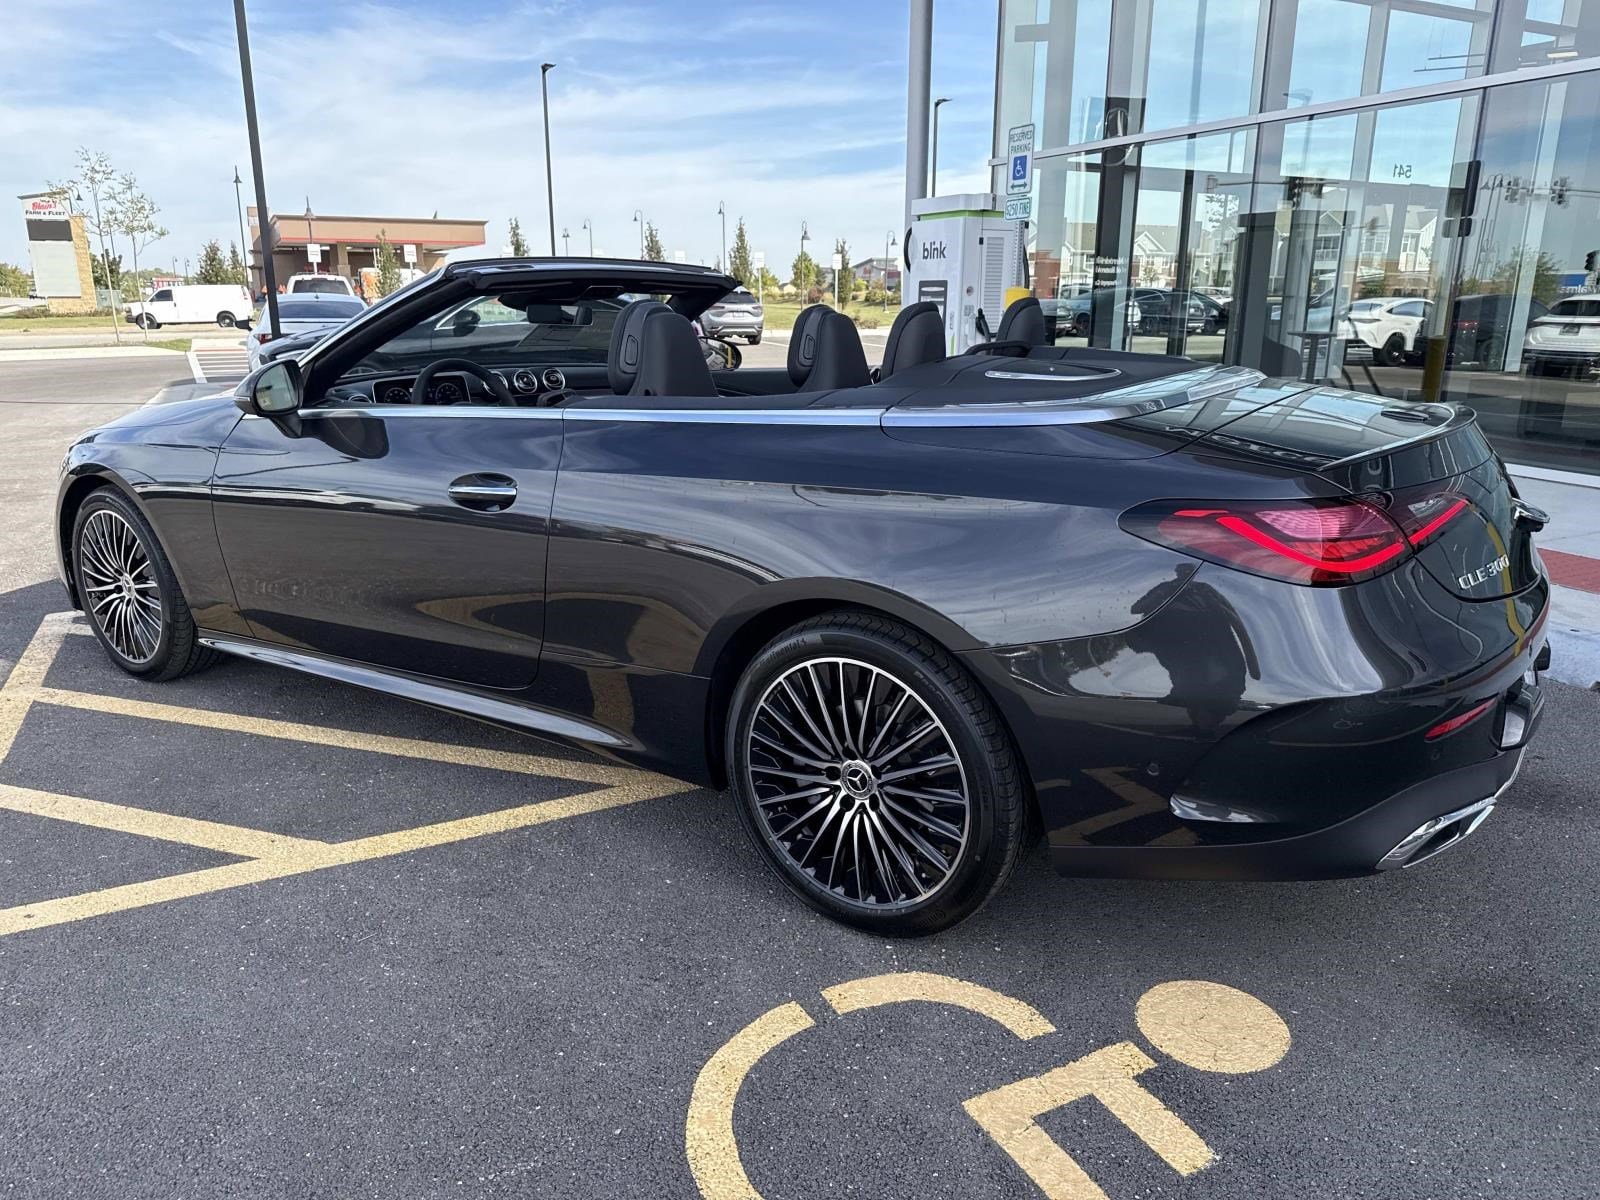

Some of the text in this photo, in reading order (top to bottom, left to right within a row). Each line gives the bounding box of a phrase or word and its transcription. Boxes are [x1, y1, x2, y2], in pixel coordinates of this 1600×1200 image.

[1010, 130, 1033, 143] RESERVED
[1010, 142, 1031, 153] PARKING
[1018, 200, 1030, 215] FINE
[922, 241, 947, 260] blink
[1459, 554, 1510, 589] CLE 300
